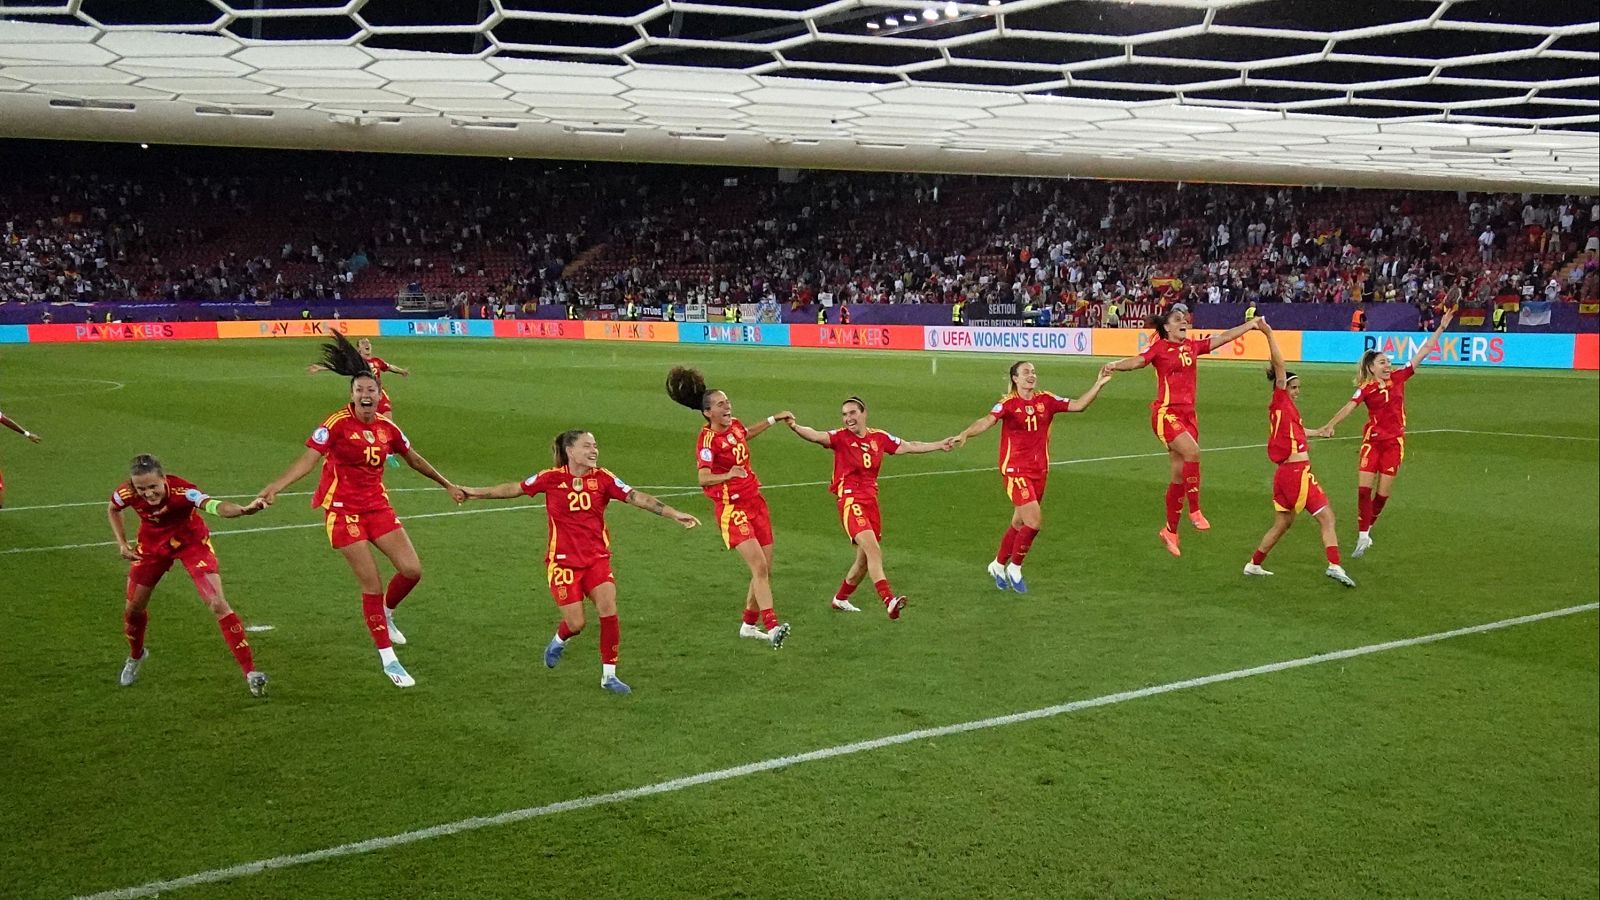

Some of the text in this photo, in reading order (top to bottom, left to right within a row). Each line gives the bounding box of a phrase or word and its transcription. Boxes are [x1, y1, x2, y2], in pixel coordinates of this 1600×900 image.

[988, 303, 1017, 315] SEKTION
[75, 324, 174, 339] PLAYMAKERS
[604, 323, 655, 339] PAYAKS
[820, 327, 890, 346] PLAYMAKERS
[942, 330, 1067, 349] UEFA WOMEN'S EURO
[1178, 351, 1193, 367] 16
[1379, 388, 1389, 403] 7
[1025, 414, 1038, 432] 11
[363, 446, 381, 466] 15
[732, 442, 749, 465] 22
[862, 452, 872, 469] 8
[567, 491, 592, 512] 20
[851, 503, 863, 517] 8
[553, 567, 574, 586] 20
